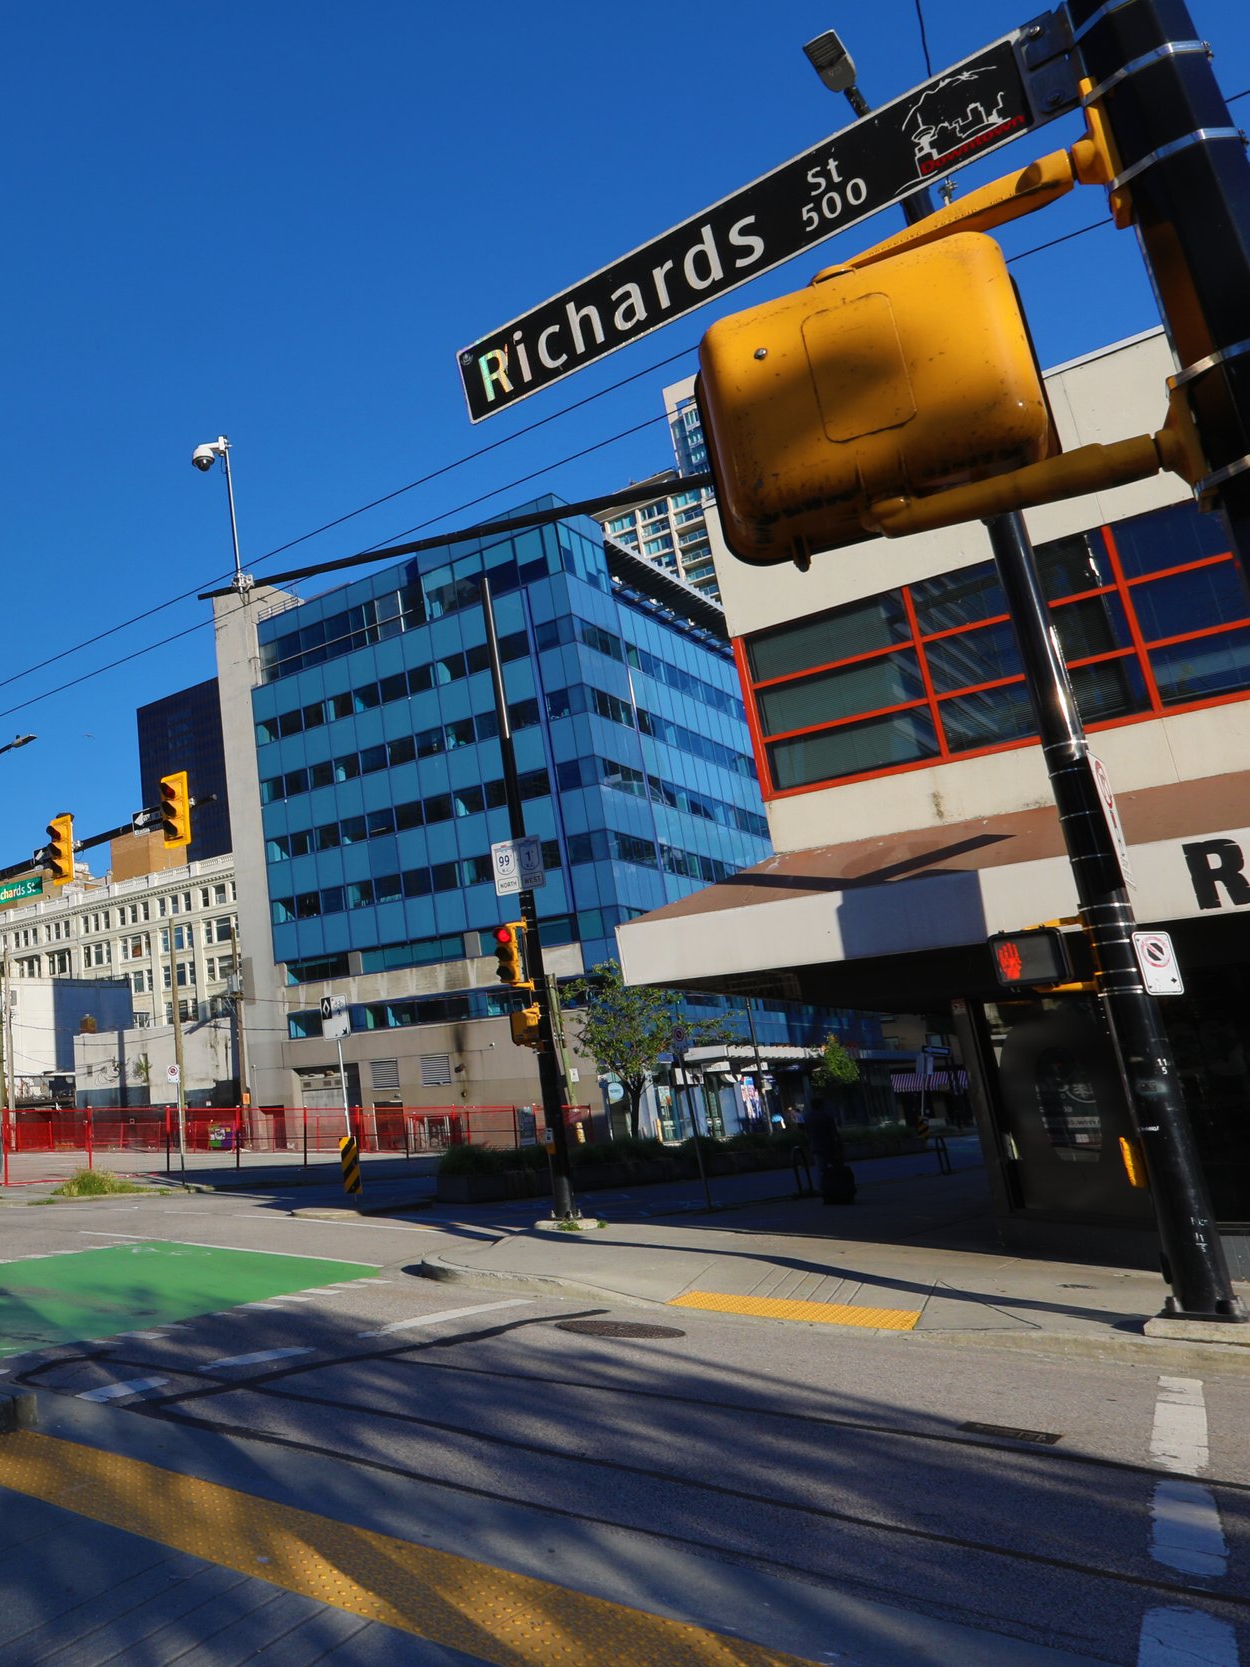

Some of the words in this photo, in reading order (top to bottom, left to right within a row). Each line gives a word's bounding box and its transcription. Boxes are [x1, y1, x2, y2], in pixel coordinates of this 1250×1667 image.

[920, 114, 1025, 175] Downtown
[807, 157, 843, 196] St
[801, 178, 868, 232] 500
[477, 214, 765, 402] Richards
[498, 855, 510, 867] 99
[525, 851, 531, 862] 1
[500, 880, 517, 888] NORTH
[525, 875, 541, 884] WEST
